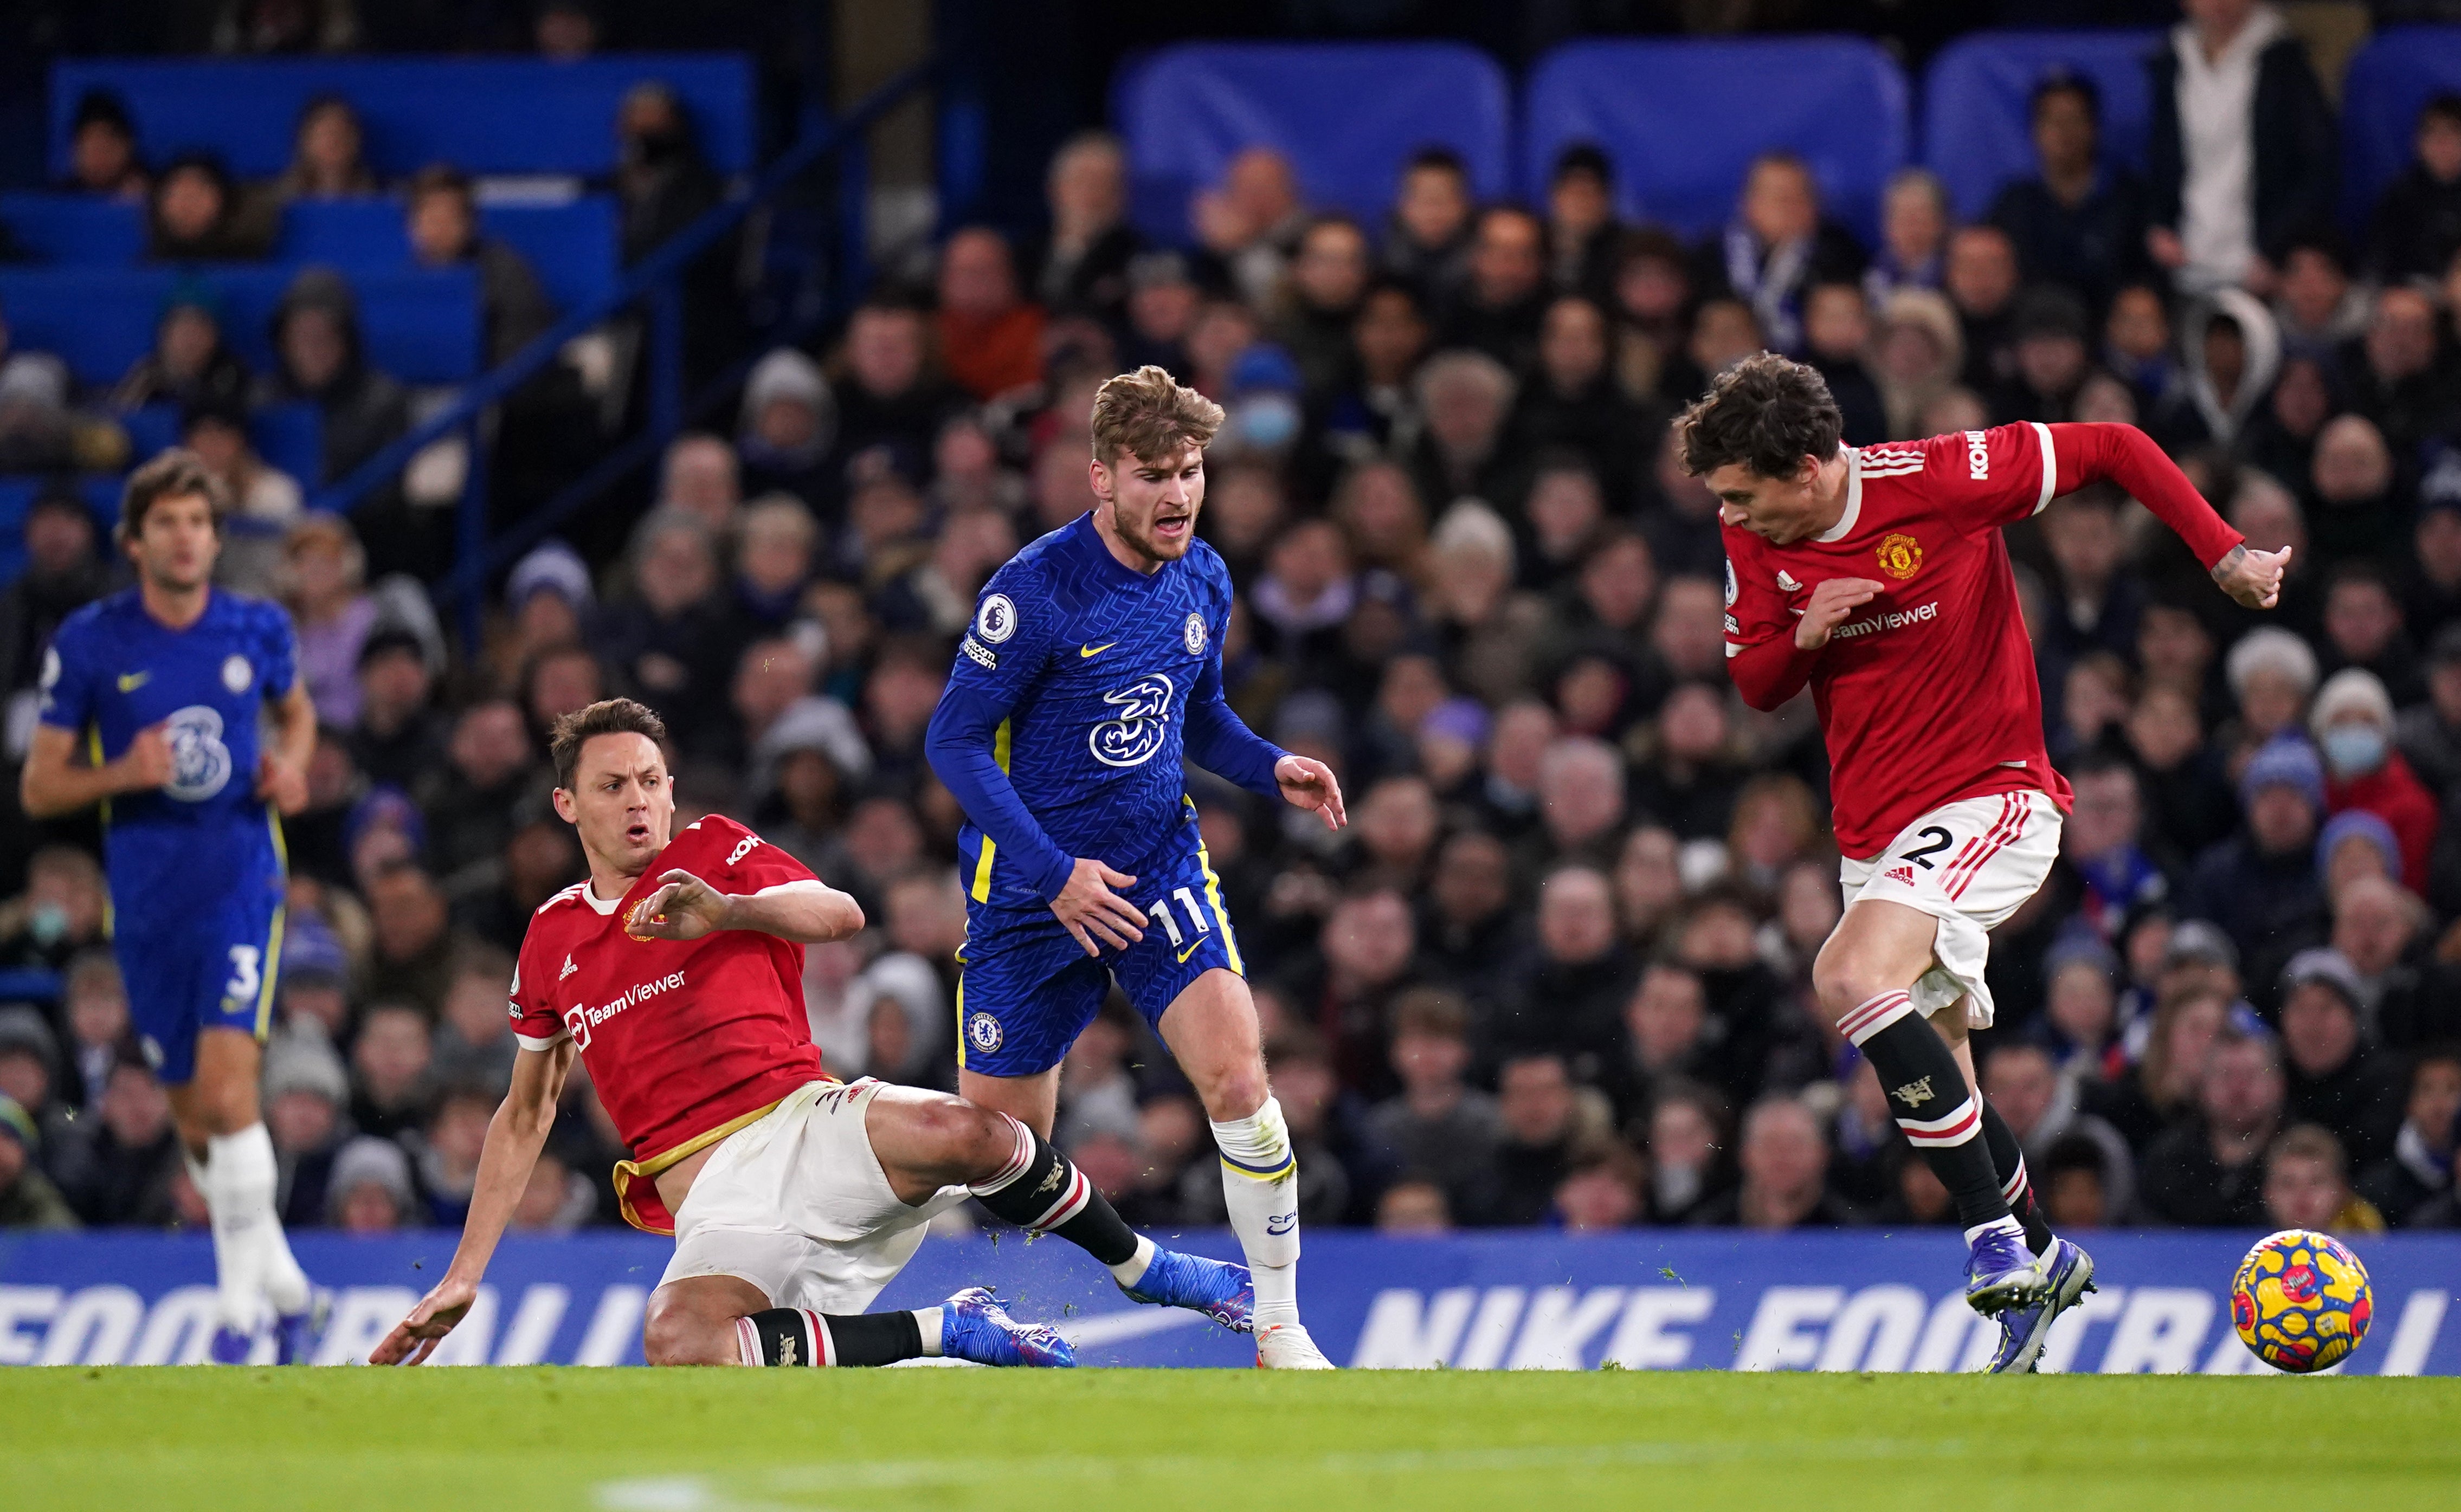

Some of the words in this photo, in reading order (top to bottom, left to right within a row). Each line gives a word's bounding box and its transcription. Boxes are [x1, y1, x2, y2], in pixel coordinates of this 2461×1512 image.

[1898, 825, 1953, 870] 2
[1885, 871, 1915, 887] adidas
[1149, 887, 1210, 948] 11
[226, 944, 260, 1001] 3
[585, 970, 685, 1028] TeamViewer
[1350, 1285, 1716, 1371] NIKE
